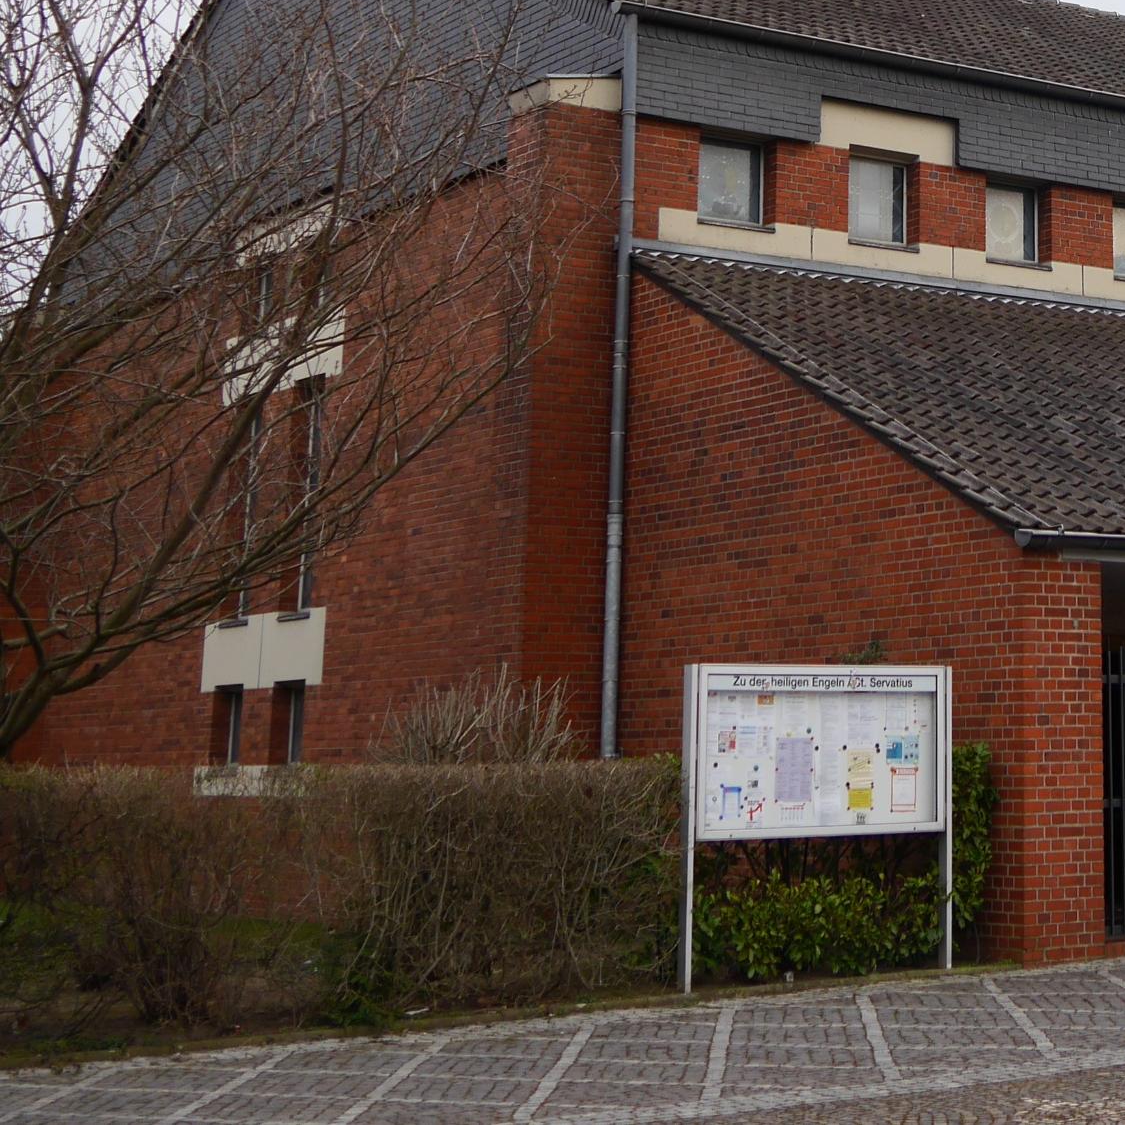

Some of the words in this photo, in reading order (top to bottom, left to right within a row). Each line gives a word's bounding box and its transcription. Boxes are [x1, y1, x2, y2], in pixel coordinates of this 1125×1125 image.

[733, 675, 746, 687] Zu
[771, 676, 809, 690] heiligen
[812, 677, 845, 690] Engeln
[870, 677, 913, 688] Servatius
